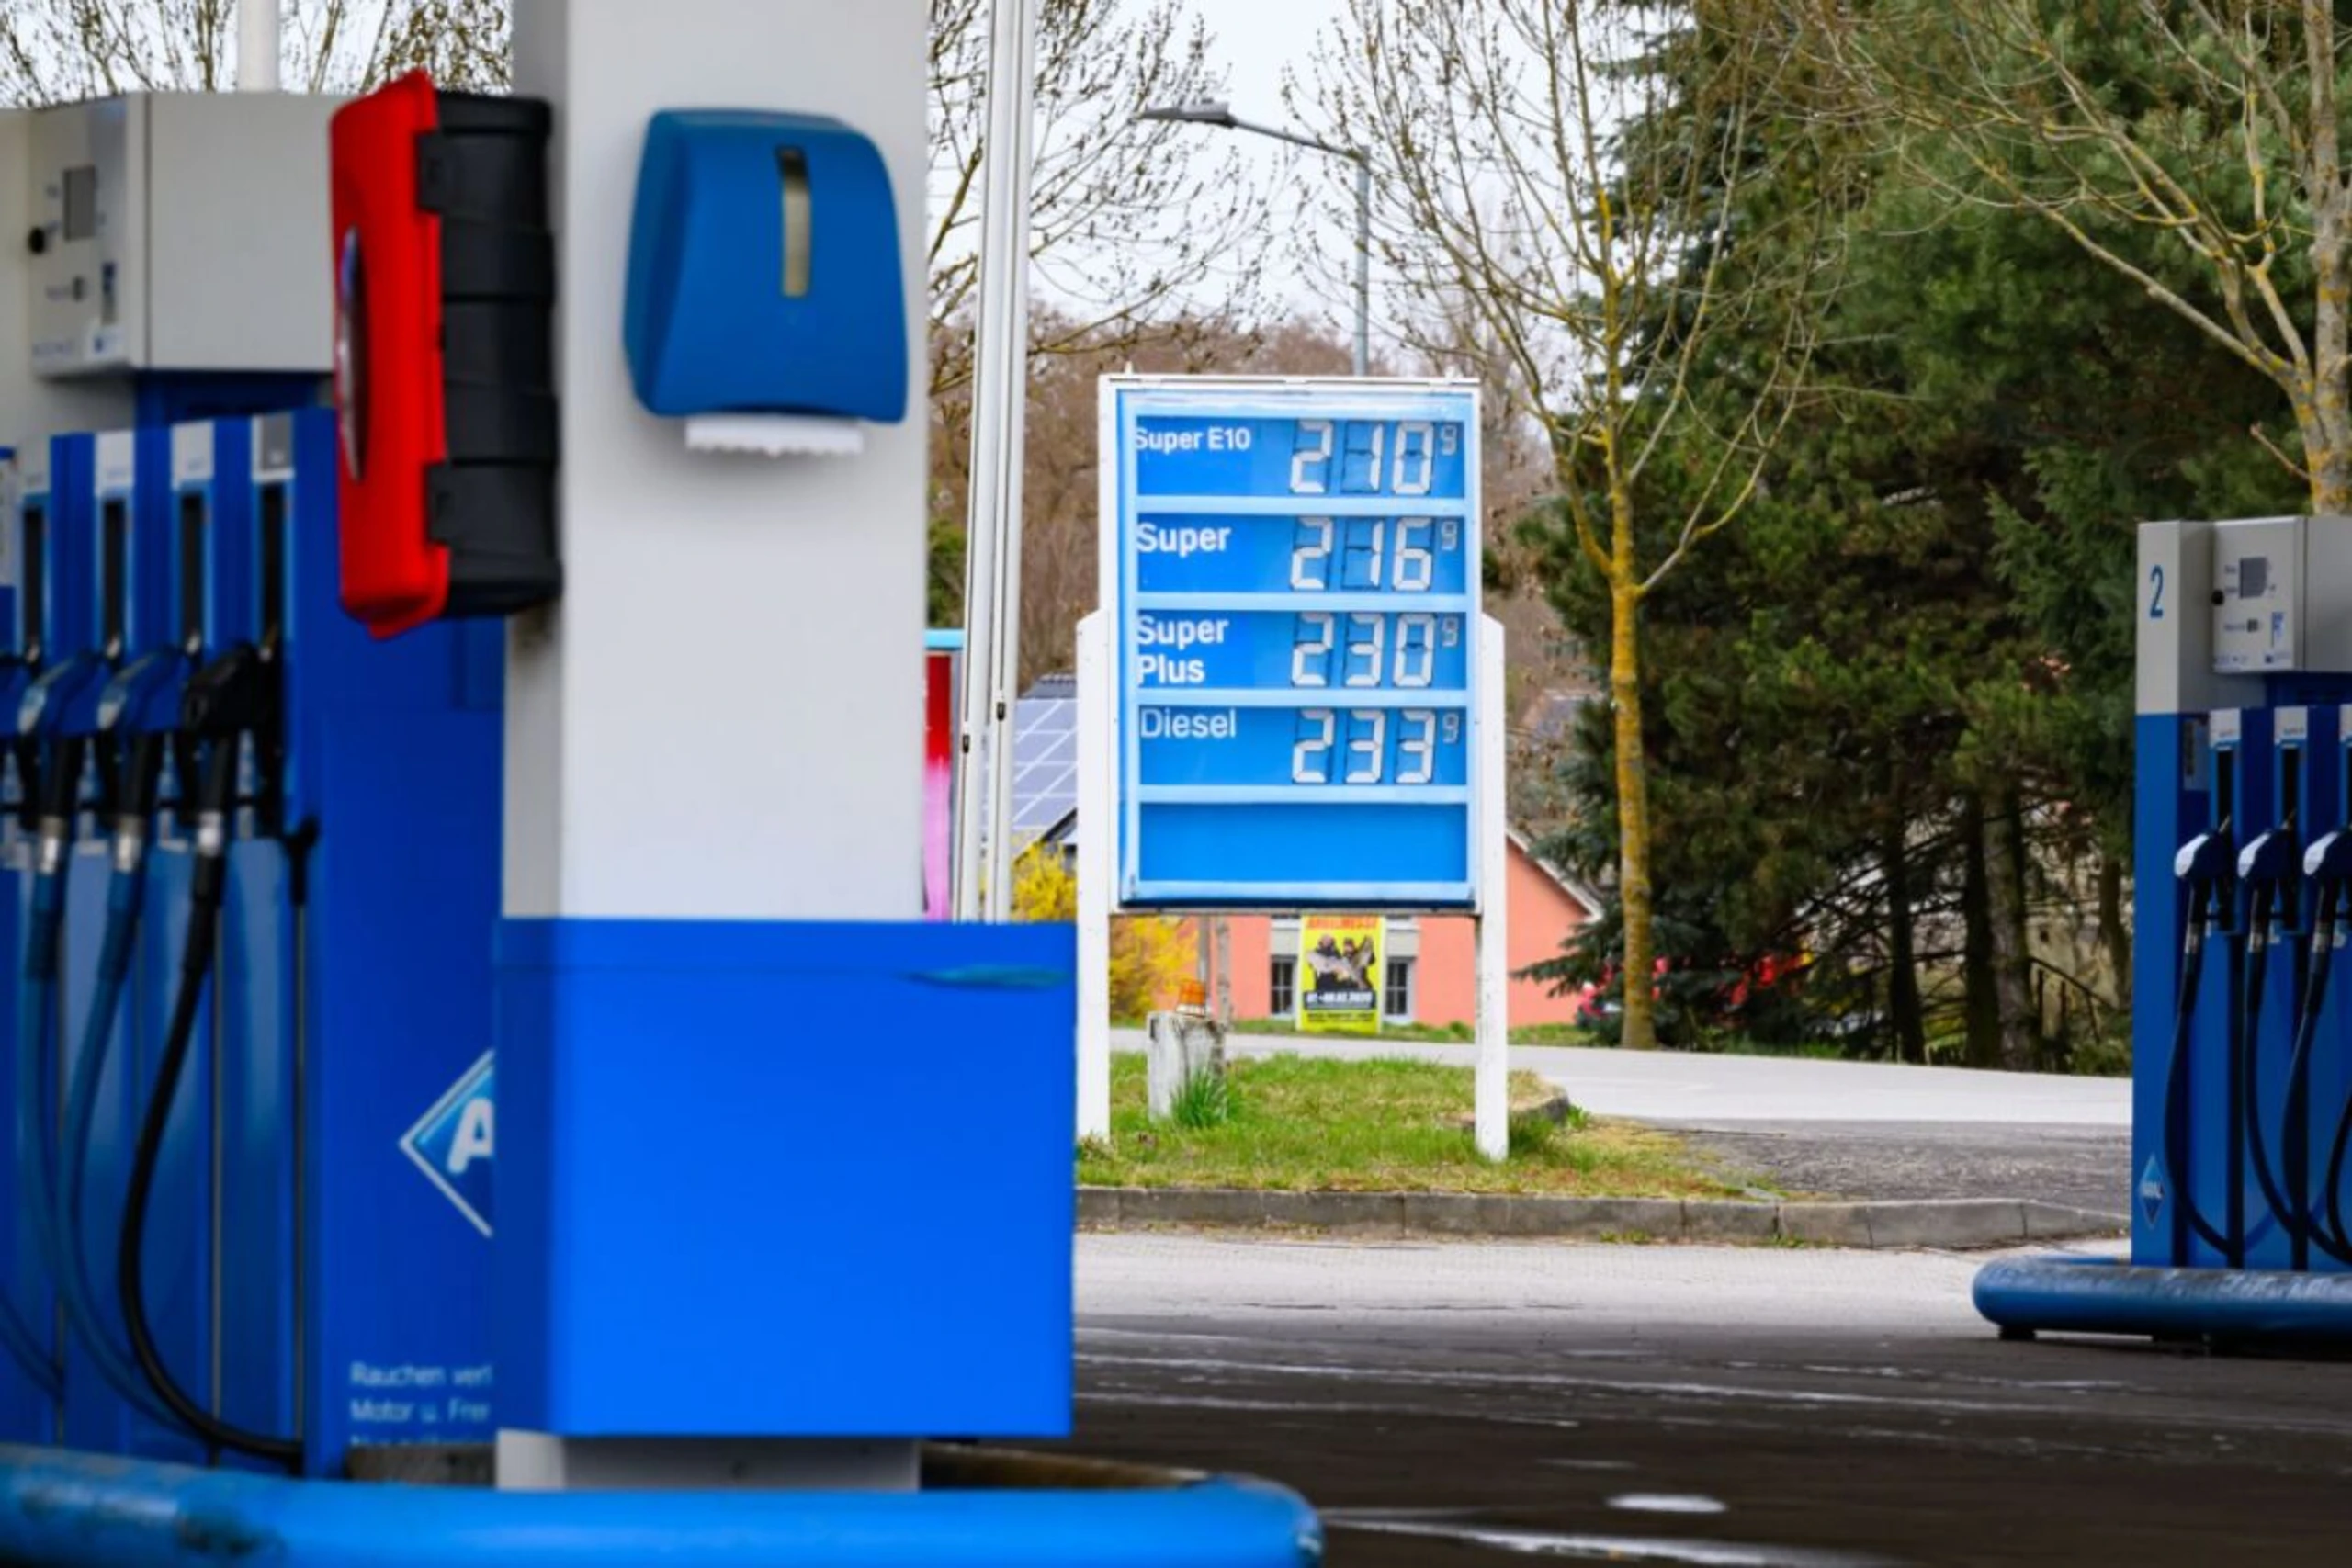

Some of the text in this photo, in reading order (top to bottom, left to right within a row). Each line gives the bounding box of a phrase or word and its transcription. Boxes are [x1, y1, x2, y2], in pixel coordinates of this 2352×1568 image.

[1135, 427, 1251, 454] Super E10
[1136, 524, 1231, 558] Super
[2149, 564, 2164, 618] 2
[1136, 617, 1229, 649] Super
[1136, 654, 1205, 685] Plus
[1140, 707, 1237, 739] Diesel
[349, 1361, 446, 1388] Rauchen
[349, 1398, 413, 1423] Motor
